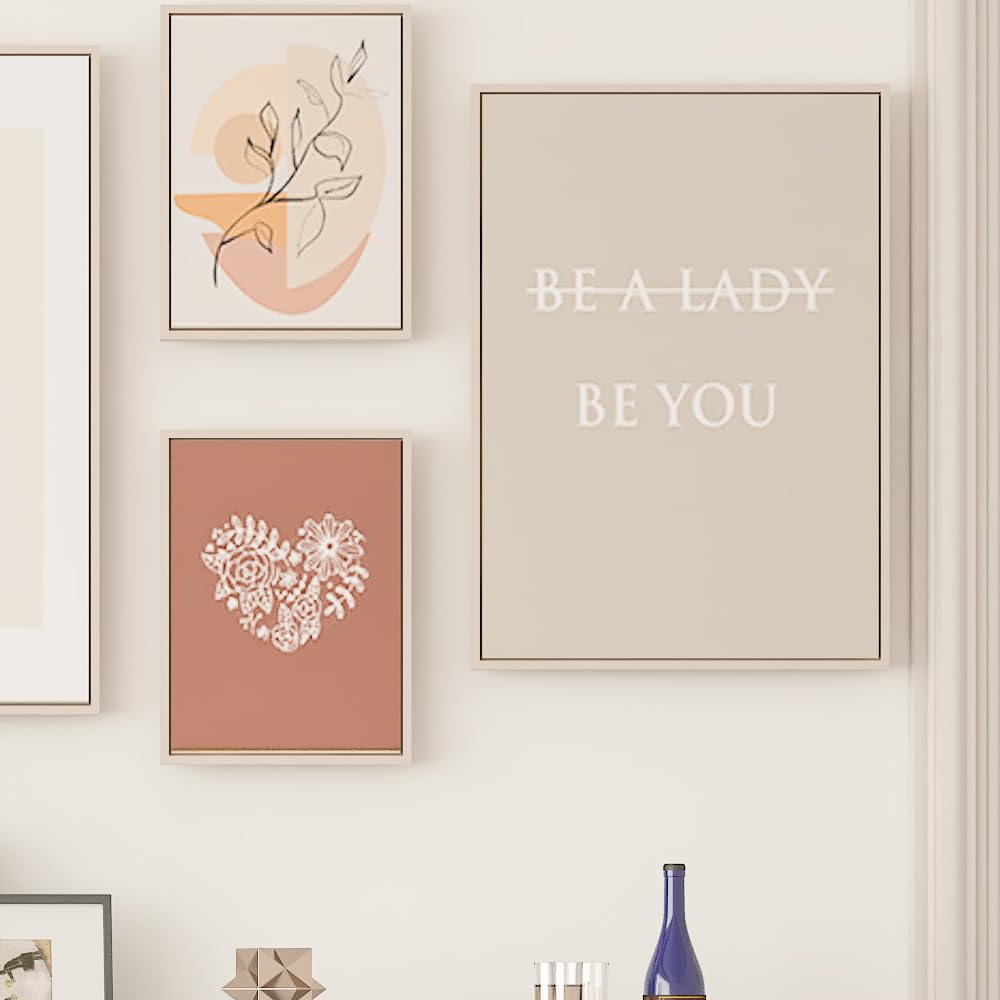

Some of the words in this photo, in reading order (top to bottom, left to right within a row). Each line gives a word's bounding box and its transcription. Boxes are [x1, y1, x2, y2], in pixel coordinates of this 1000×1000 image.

[532, 267, 598, 312] BE
[618, 268, 656, 312] A
[680, 267, 832, 312] LADY
[577, 382, 638, 428] BE
[656, 382, 777, 428] YOU
